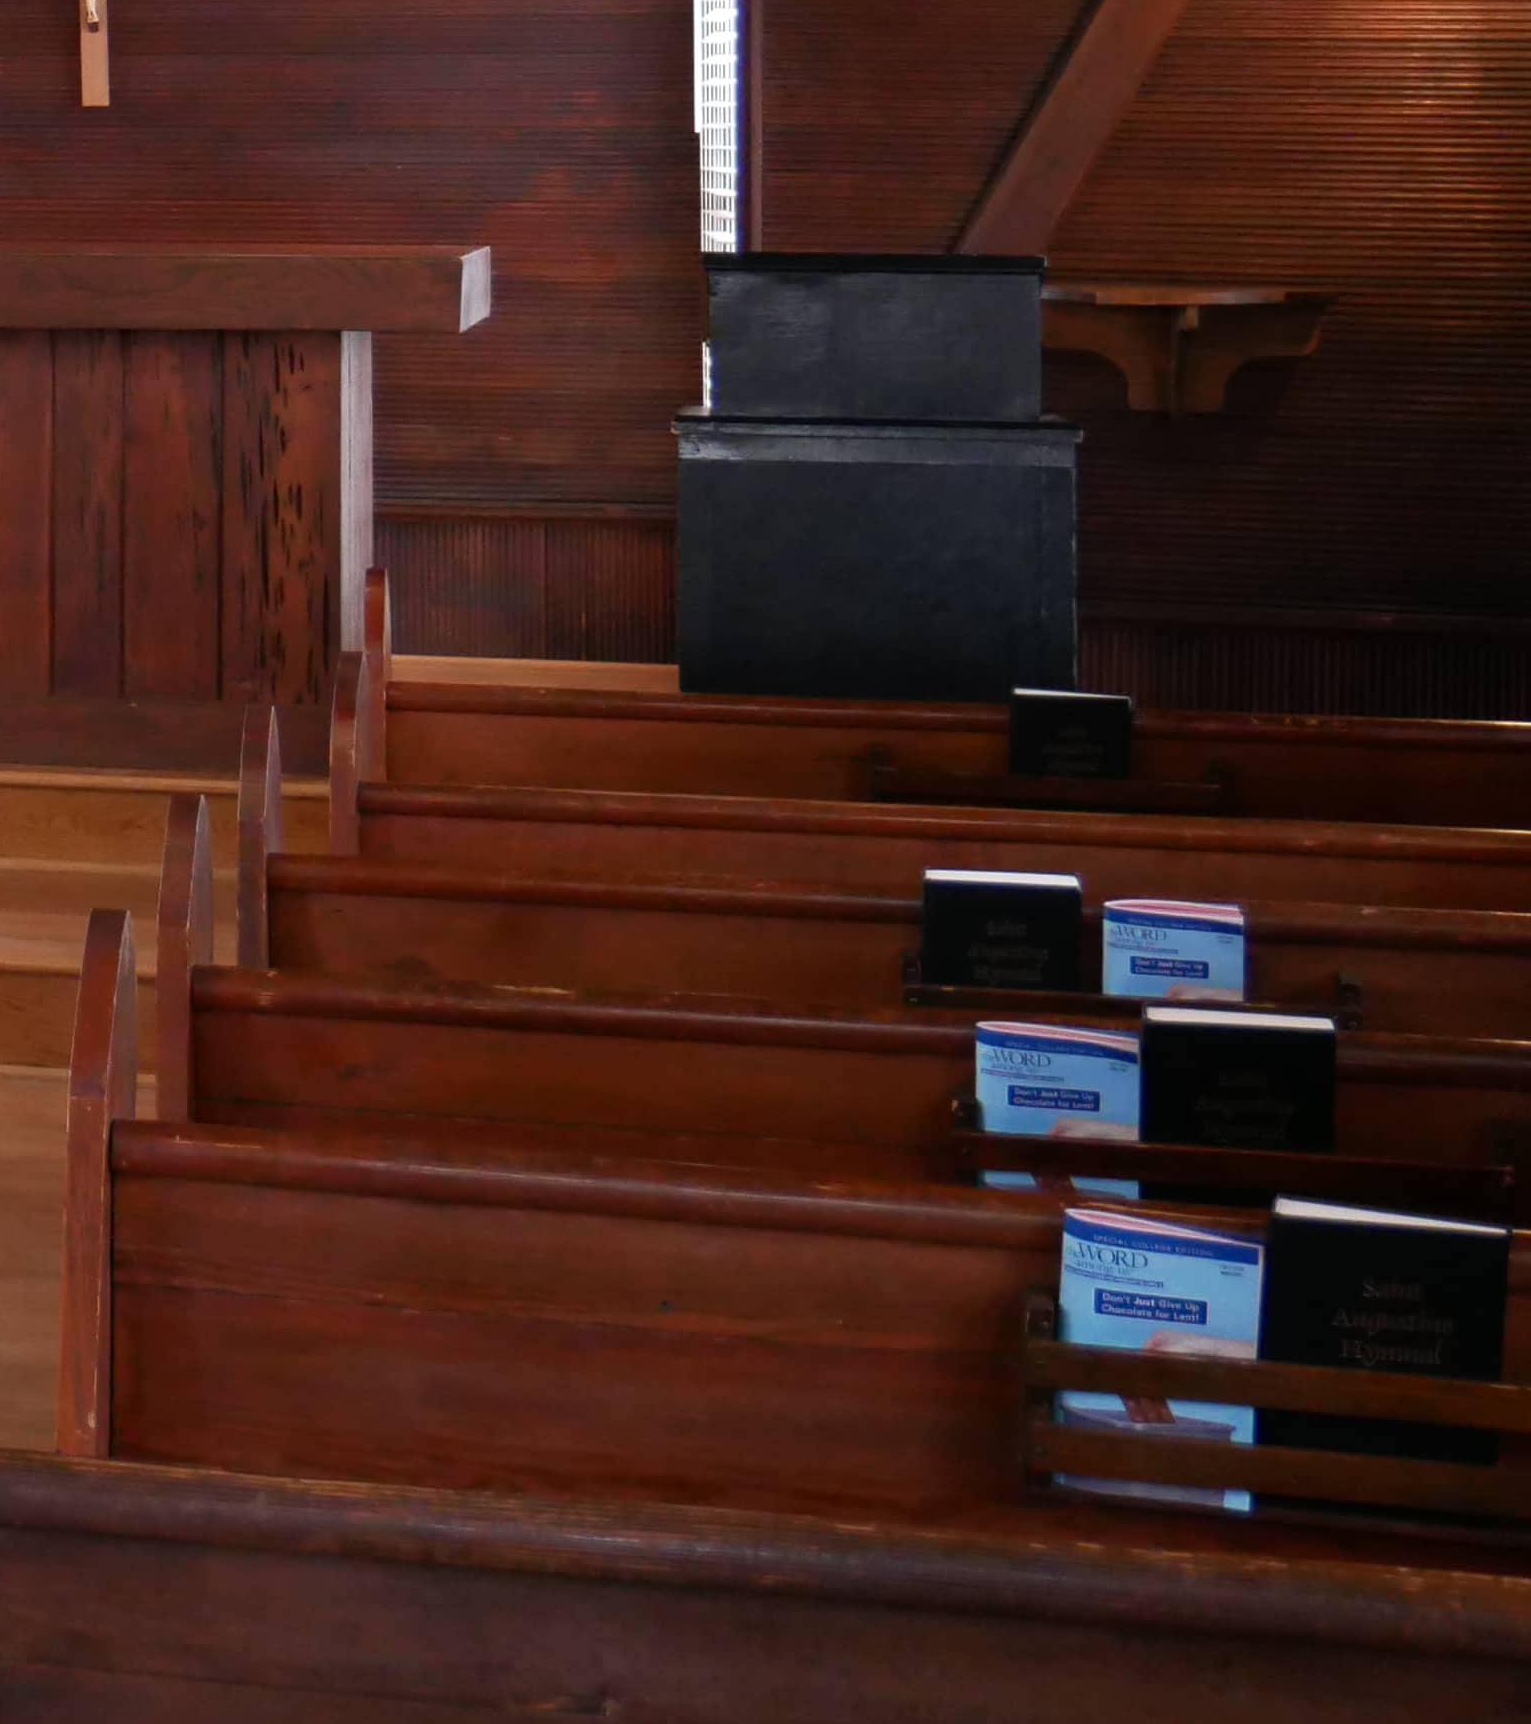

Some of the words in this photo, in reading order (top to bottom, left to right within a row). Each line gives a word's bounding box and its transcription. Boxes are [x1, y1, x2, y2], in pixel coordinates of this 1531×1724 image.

[993, 1049, 1051, 1067] WORD
[1078, 1242, 1148, 1268] WORD
[1100, 1304, 1152, 1318] Chocolate
[1155, 1309, 1171, 1319] for
[1101, 1291, 1132, 1304] Don't
[1134, 1296, 1156, 1307] Just
[1158, 1298, 1182, 1310] Give
[1185, 1301, 1200, 1314] Up
[1330, 1307, 1455, 1336] Augustine
[1339, 1338, 1443, 1366] Hymnal
